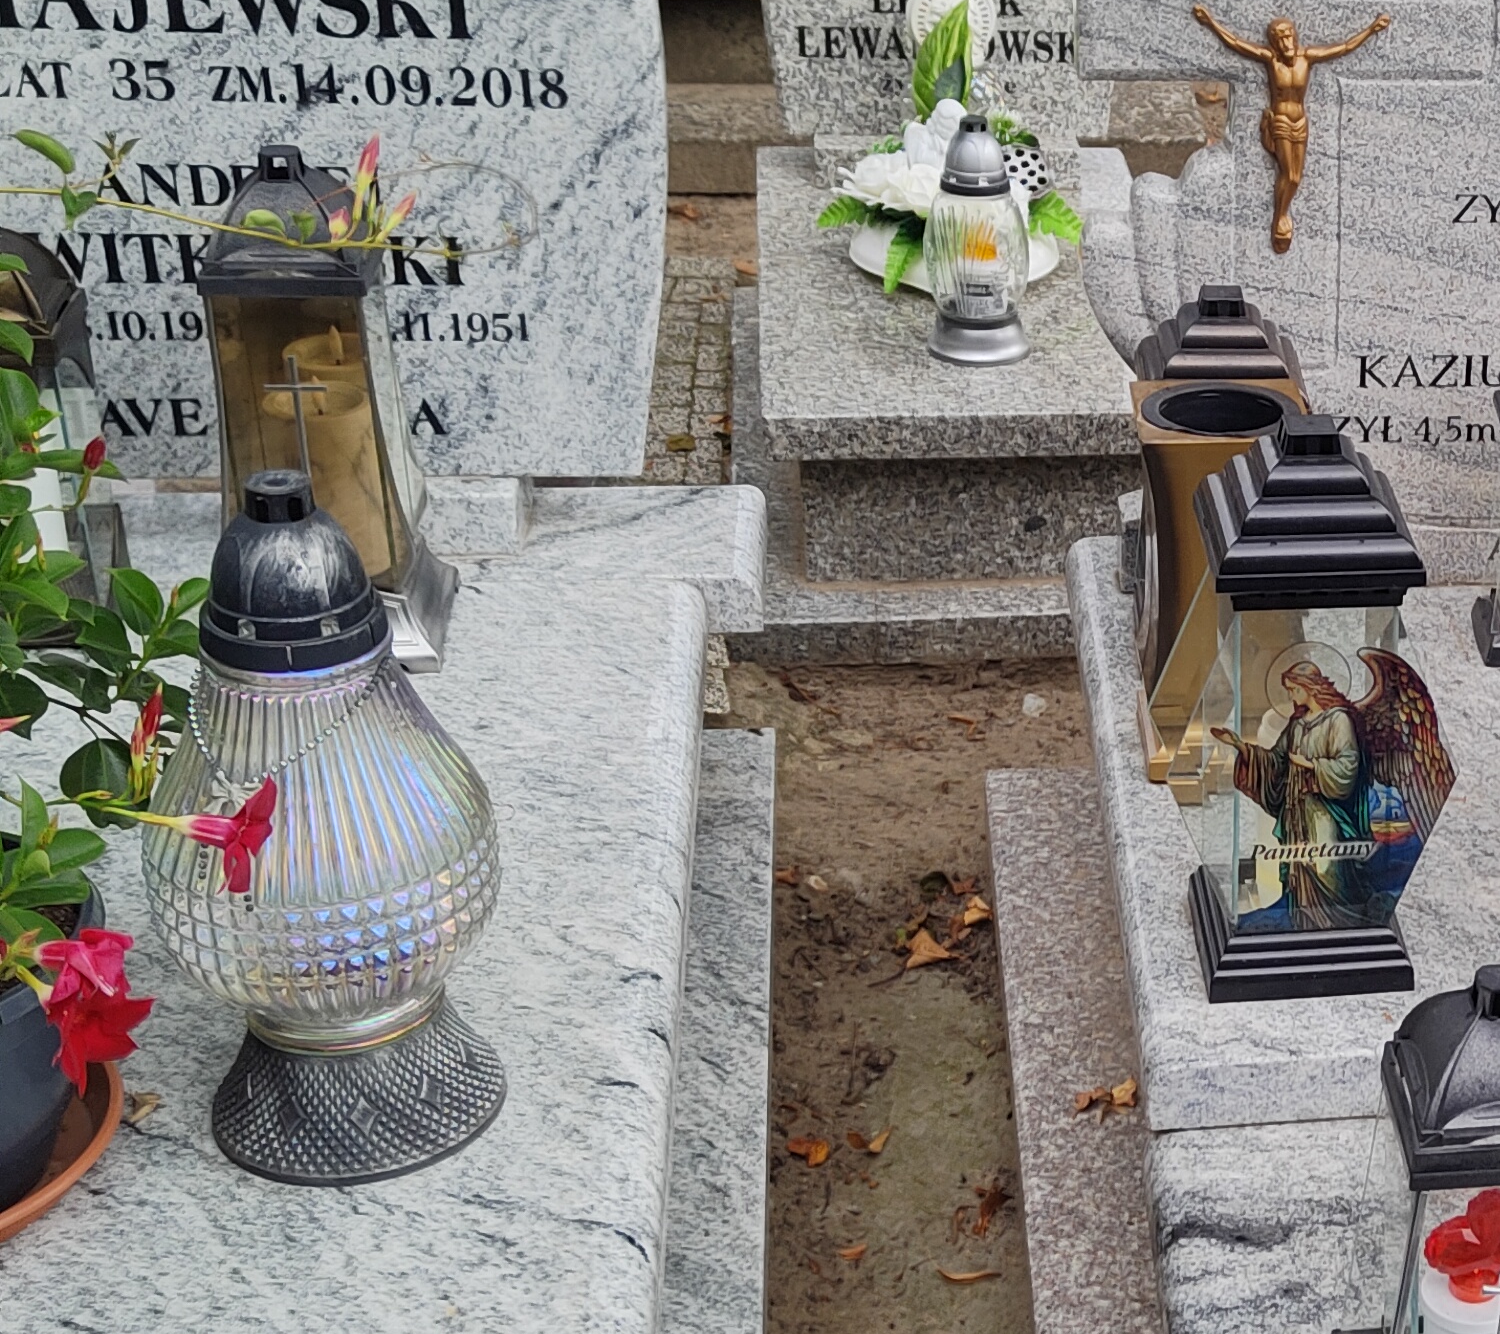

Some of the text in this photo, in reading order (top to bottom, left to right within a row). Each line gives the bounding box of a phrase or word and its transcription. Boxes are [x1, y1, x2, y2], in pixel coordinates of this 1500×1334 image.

[108, 58, 176, 102] 35
[100, 398, 210, 437] AVE
[1251, 840, 1379, 863] Pamiętamy
